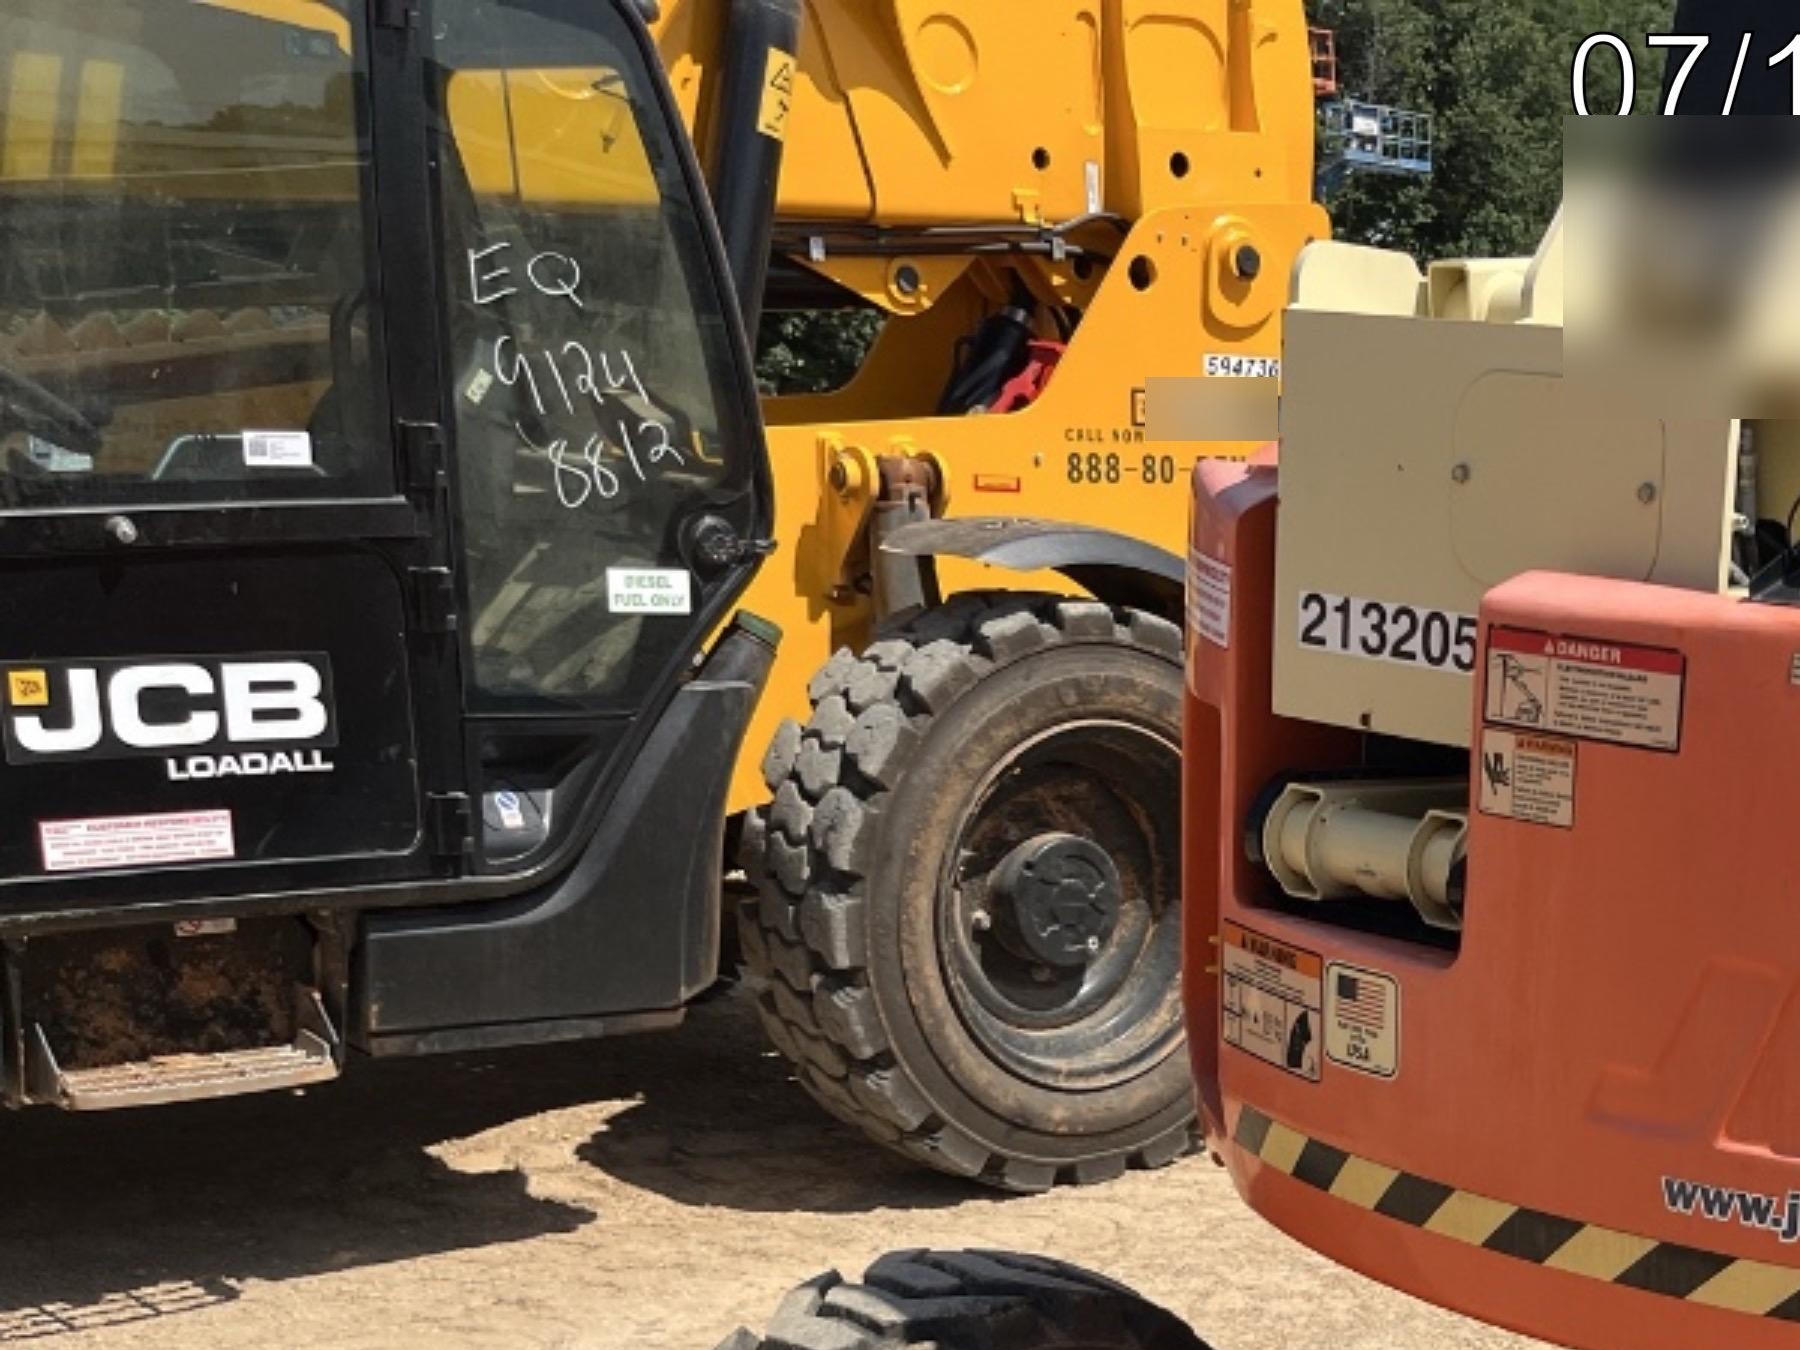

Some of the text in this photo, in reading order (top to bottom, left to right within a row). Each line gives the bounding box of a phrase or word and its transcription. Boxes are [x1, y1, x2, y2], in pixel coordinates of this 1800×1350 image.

[468, 242, 583, 307] EQ
[494, 335, 650, 415] 9124
[1301, 593, 1477, 671] 213205
[1557, 641, 1621, 664] DANGER
[14, 662, 328, 752] JCB
[167, 750, 334, 780] LOADALL
